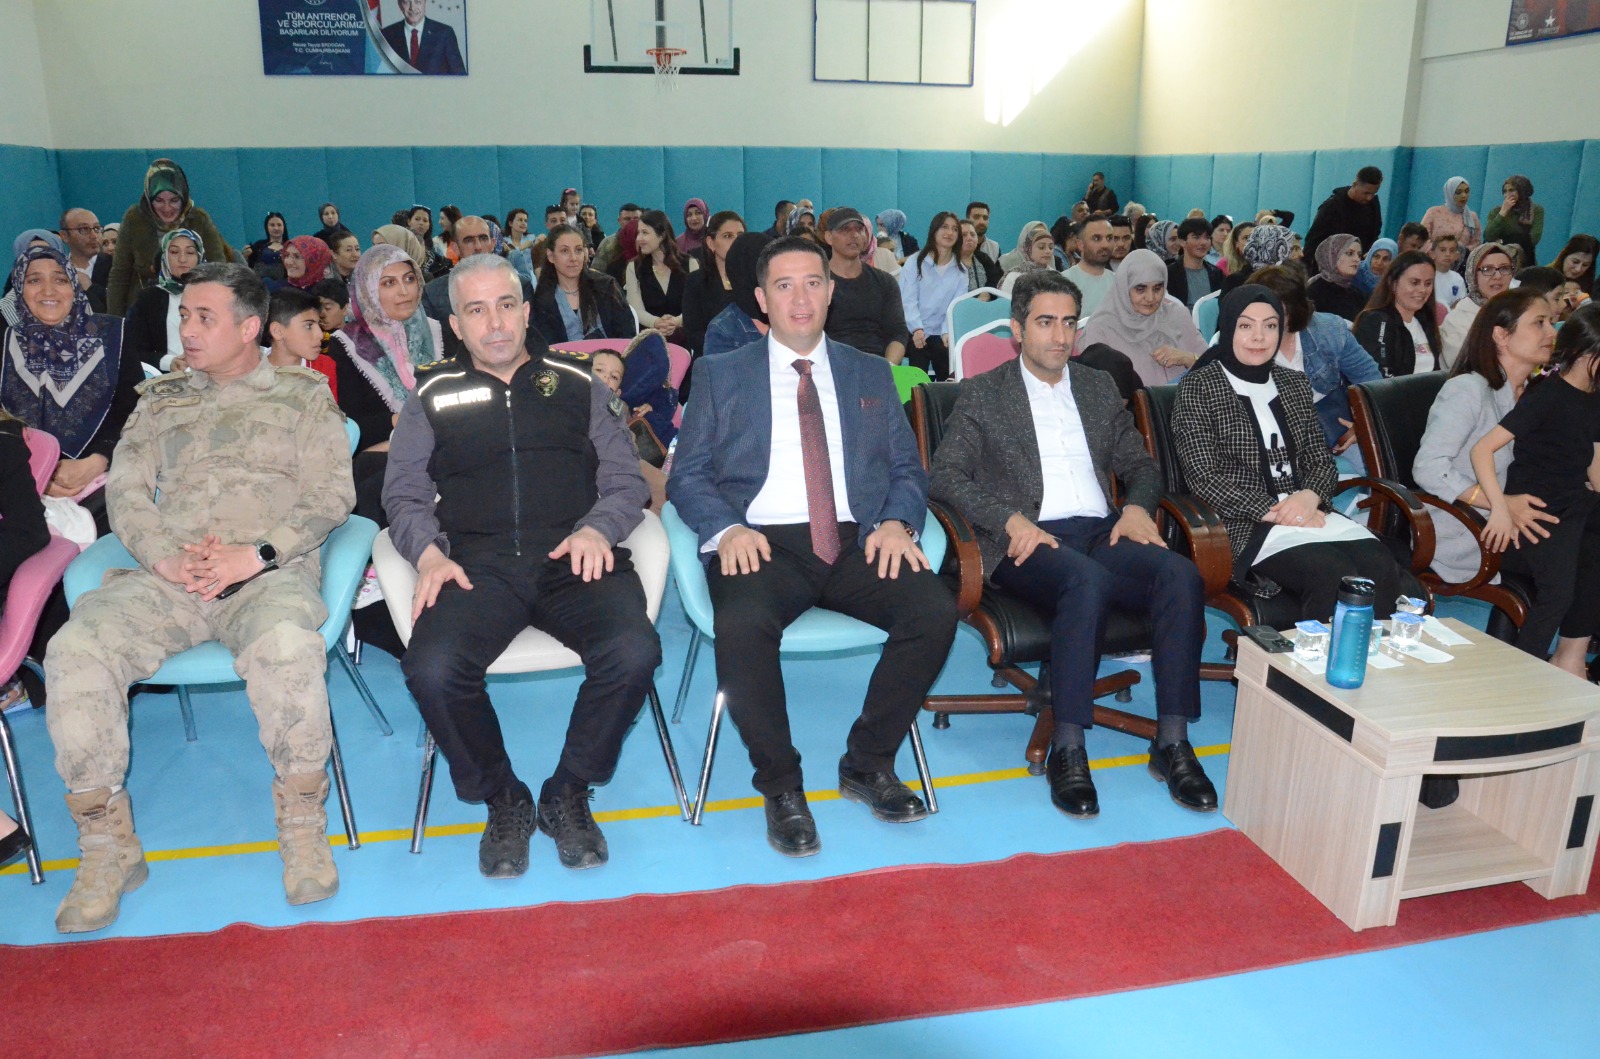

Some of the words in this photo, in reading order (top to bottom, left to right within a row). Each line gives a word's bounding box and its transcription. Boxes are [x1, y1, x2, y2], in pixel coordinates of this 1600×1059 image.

[285, 11, 305, 20] TÜM
[306, 12, 357, 21] ANTRENÖR
[277, 20, 290, 28] VE
[291, 20, 365, 29] SPORCULARIMIZ
[280, 28, 319, 36] BAŞARILAR
[320, 28, 359, 36] DİLİYORUM
